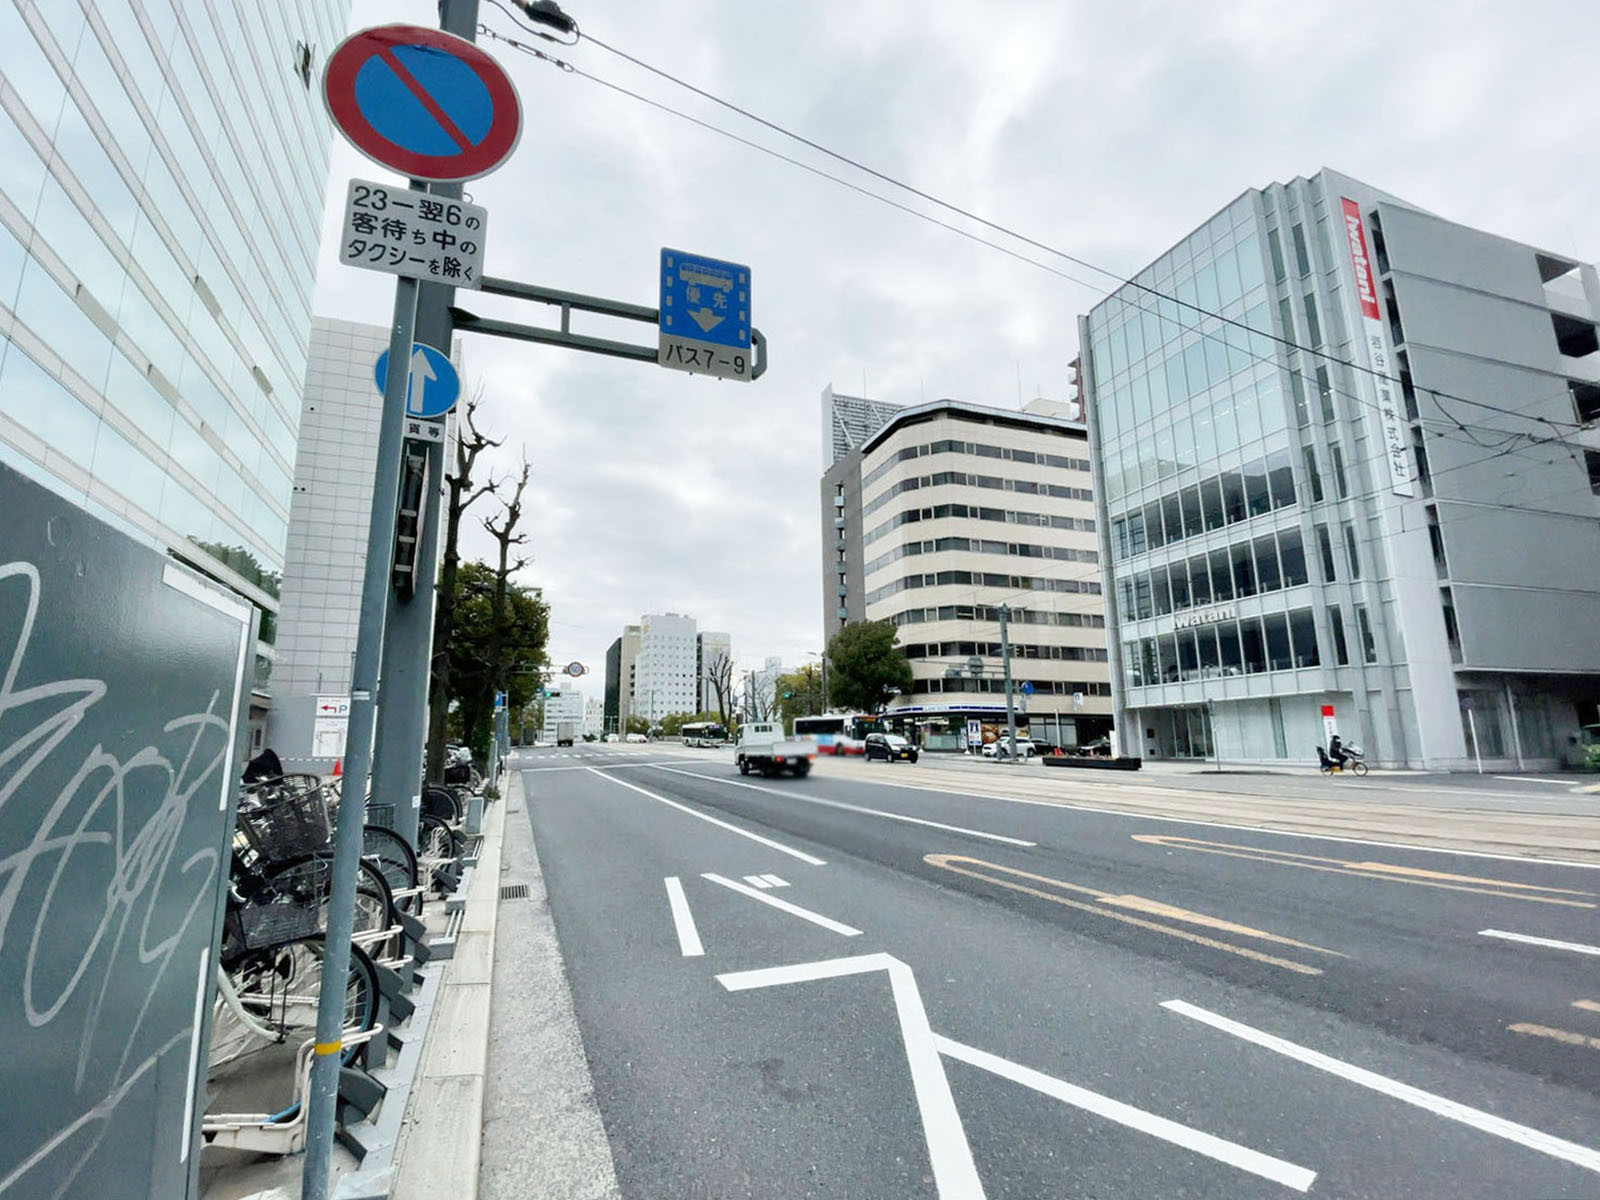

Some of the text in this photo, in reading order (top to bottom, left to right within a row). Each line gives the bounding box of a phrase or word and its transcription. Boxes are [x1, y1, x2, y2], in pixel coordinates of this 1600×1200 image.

[351, 211, 477, 256] 客待ち中の
[347, 239, 473, 281] タクシーを除く
[1345, 214, 1375, 304] Iwatani
[338, 704, 348, 714] P
